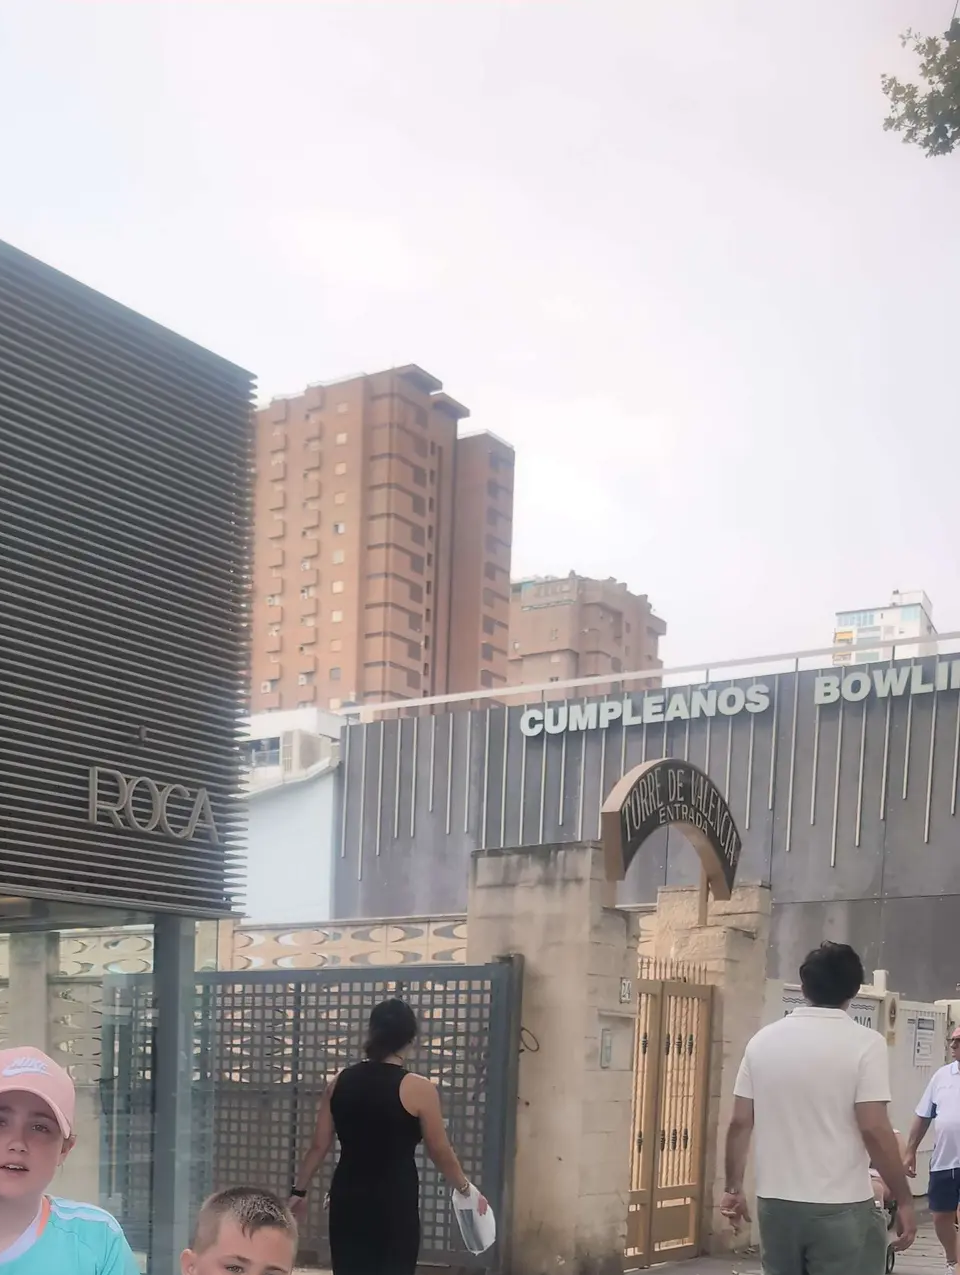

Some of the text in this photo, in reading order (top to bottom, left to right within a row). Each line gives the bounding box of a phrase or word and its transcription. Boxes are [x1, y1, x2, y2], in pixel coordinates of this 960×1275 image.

[520, 684, 770, 737] CUMPLEAÑOS
[88, 766, 220, 844] ROCA
[621, 766, 738, 867] TORRE DE VALENCIA
[658, 803, 709, 835] ENTRADA
